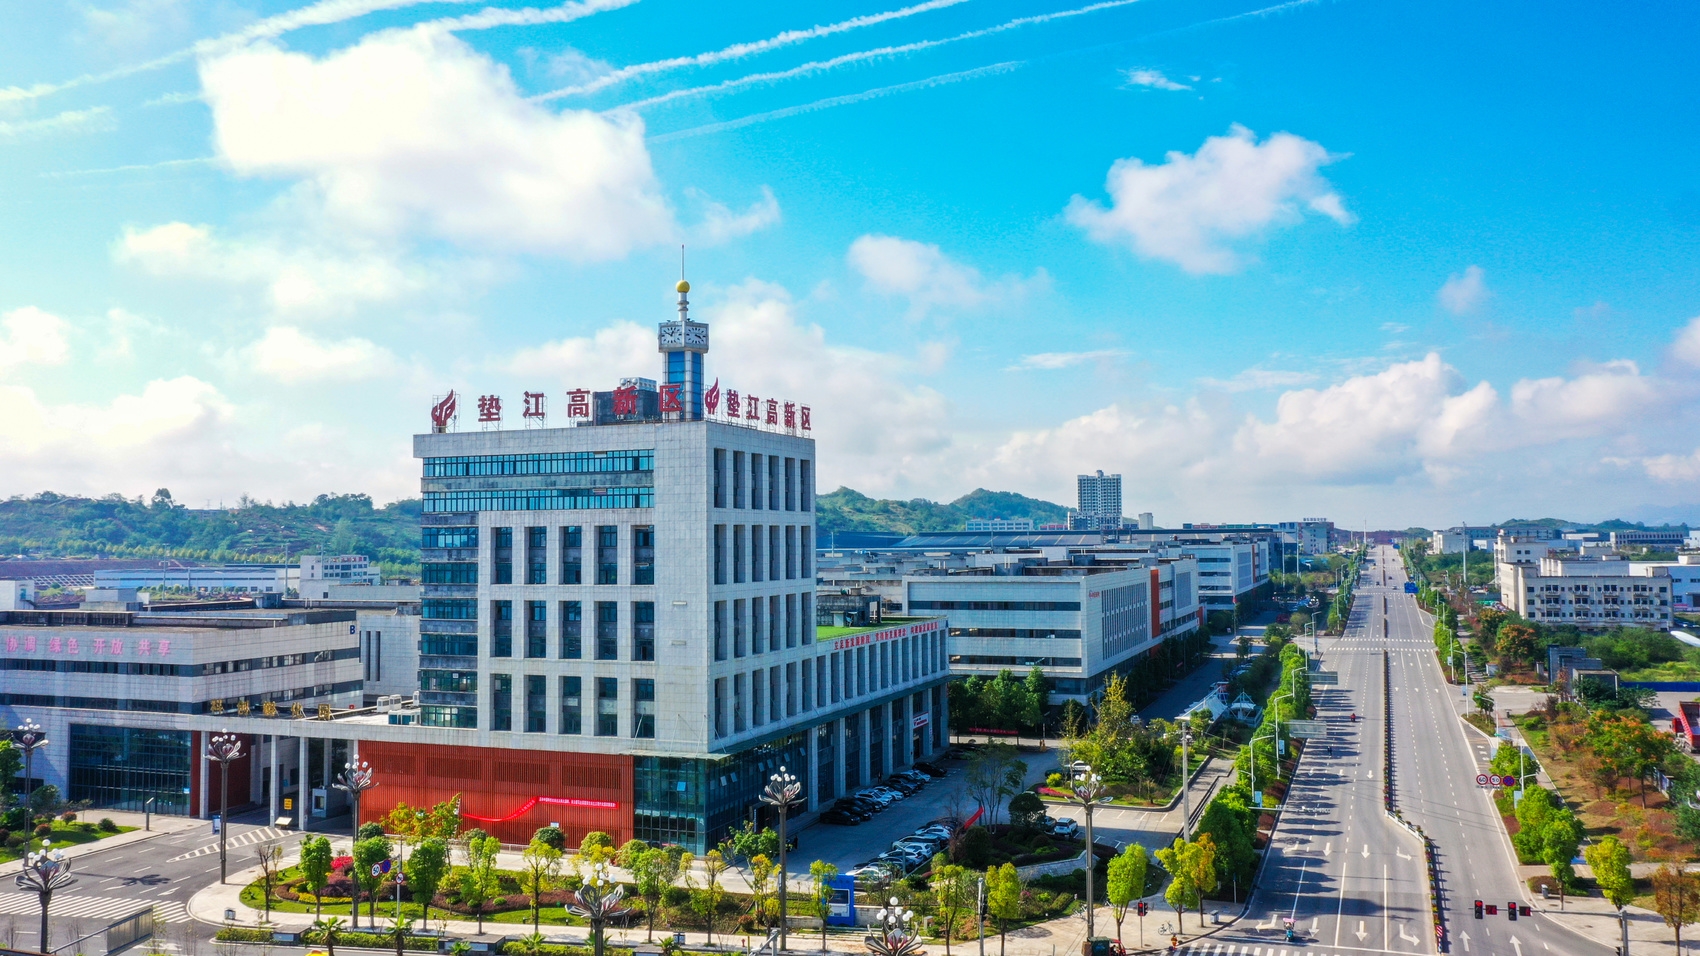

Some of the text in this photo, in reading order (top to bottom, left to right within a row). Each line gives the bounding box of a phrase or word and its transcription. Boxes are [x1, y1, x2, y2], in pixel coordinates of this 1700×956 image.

[478, 386, 683, 423] 垫江高新区
[726, 389, 812, 431] 垫江高新区
[349, 624, 356, 635] B
[5, 636, 171, 657] 协调 绿色 开放 共享
